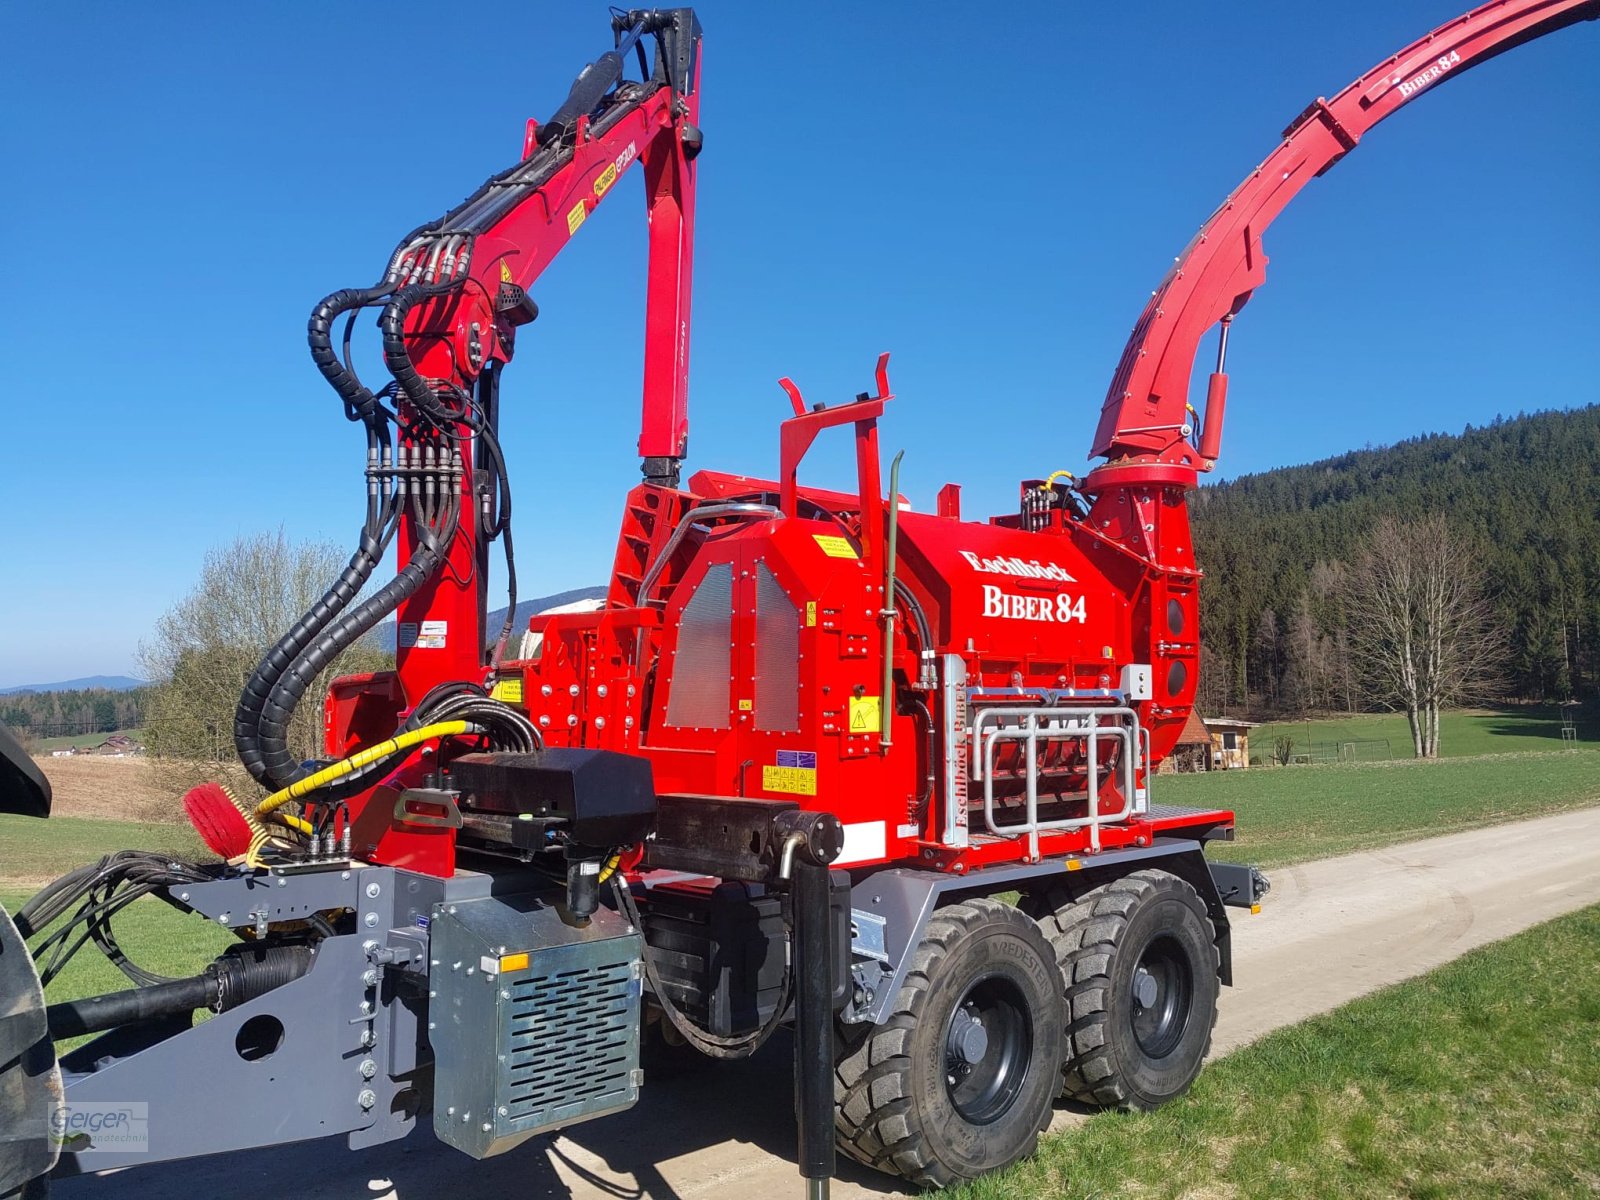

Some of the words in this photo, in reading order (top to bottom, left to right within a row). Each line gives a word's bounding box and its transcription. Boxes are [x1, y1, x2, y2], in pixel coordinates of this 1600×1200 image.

[1398, 66, 1442, 98] BIBER
[1438, 50, 1460, 71] 84
[958, 550, 1078, 582] Eschlböck
[982, 585, 1055, 622] BIBER
[1056, 593, 1086, 624] 84
[954, 736, 967, 828] Eschlböck
